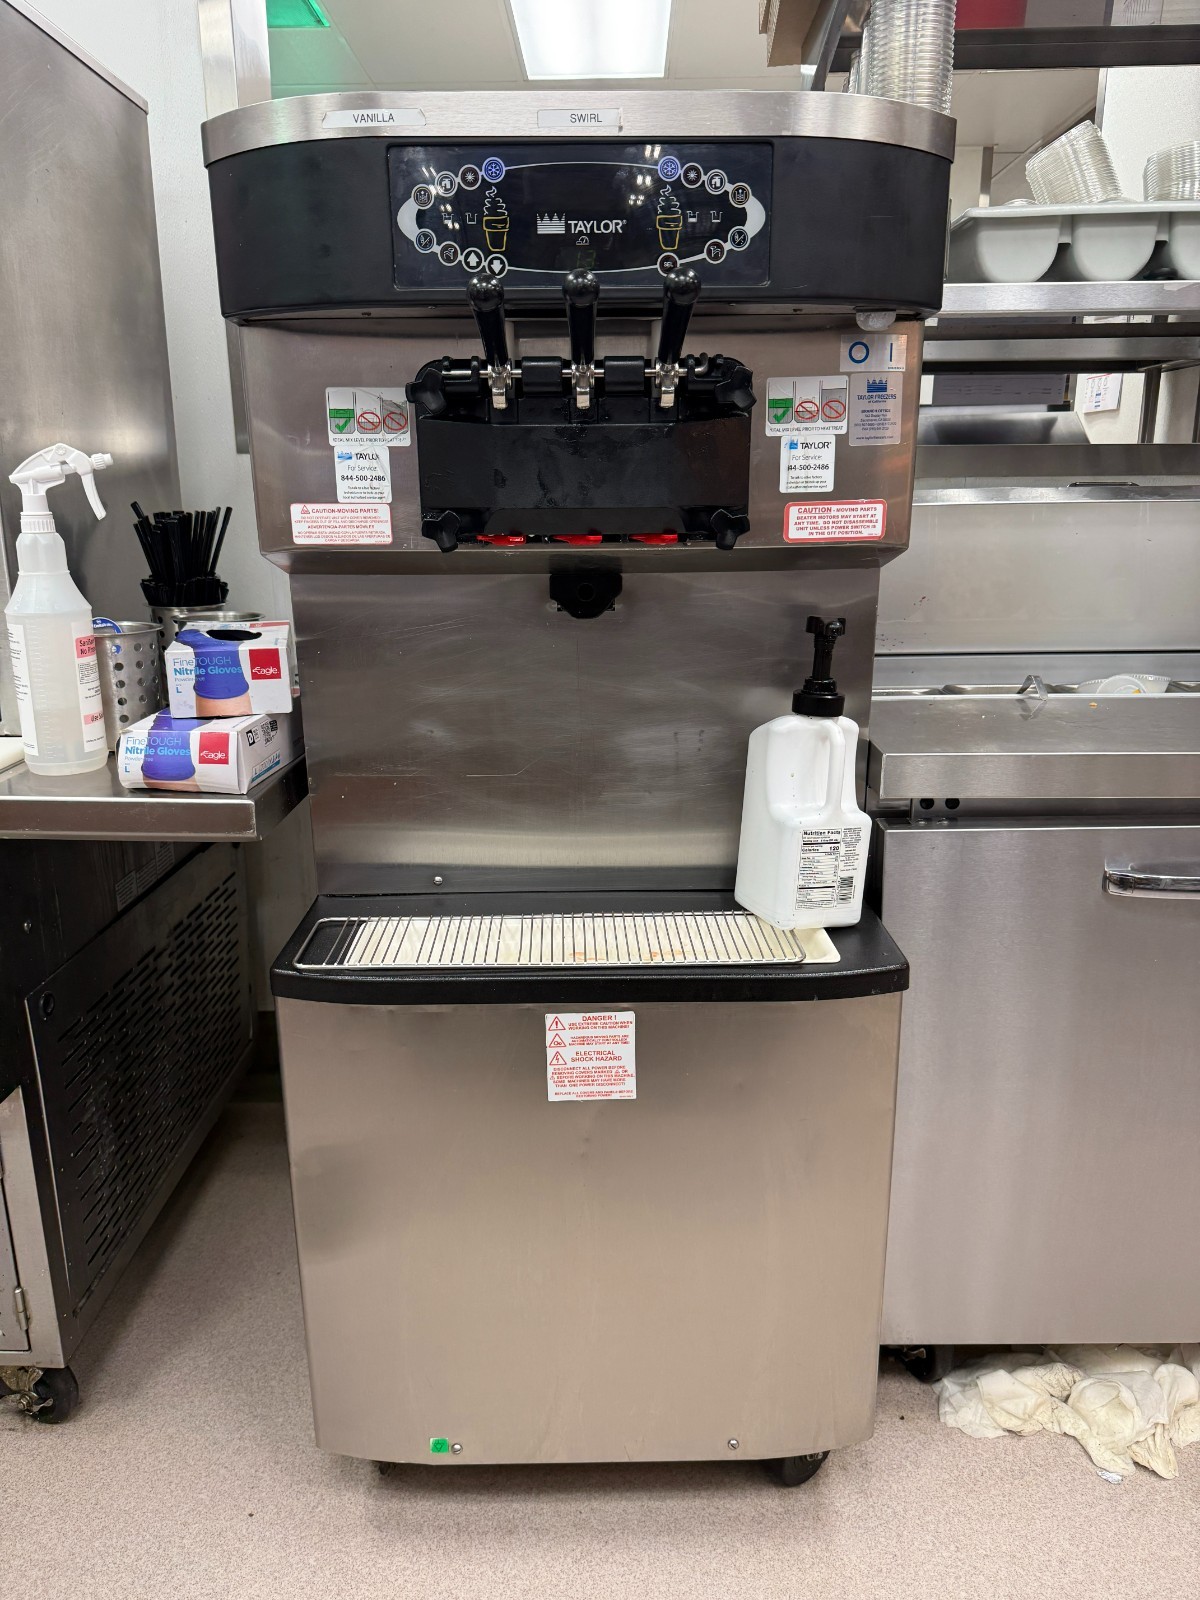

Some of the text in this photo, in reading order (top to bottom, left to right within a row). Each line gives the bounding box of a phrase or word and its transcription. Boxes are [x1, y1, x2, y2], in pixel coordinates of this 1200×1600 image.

[352, 113, 395, 124] VANILLA
[570, 113, 602, 123] SWIRL
[173, 656, 231, 666] FineTOUGH
[174, 666, 243, 676] Nitrile Gloves
[126, 736, 182, 746] FineTOUGH
[125, 746, 191, 756] Nitrile Gloves
